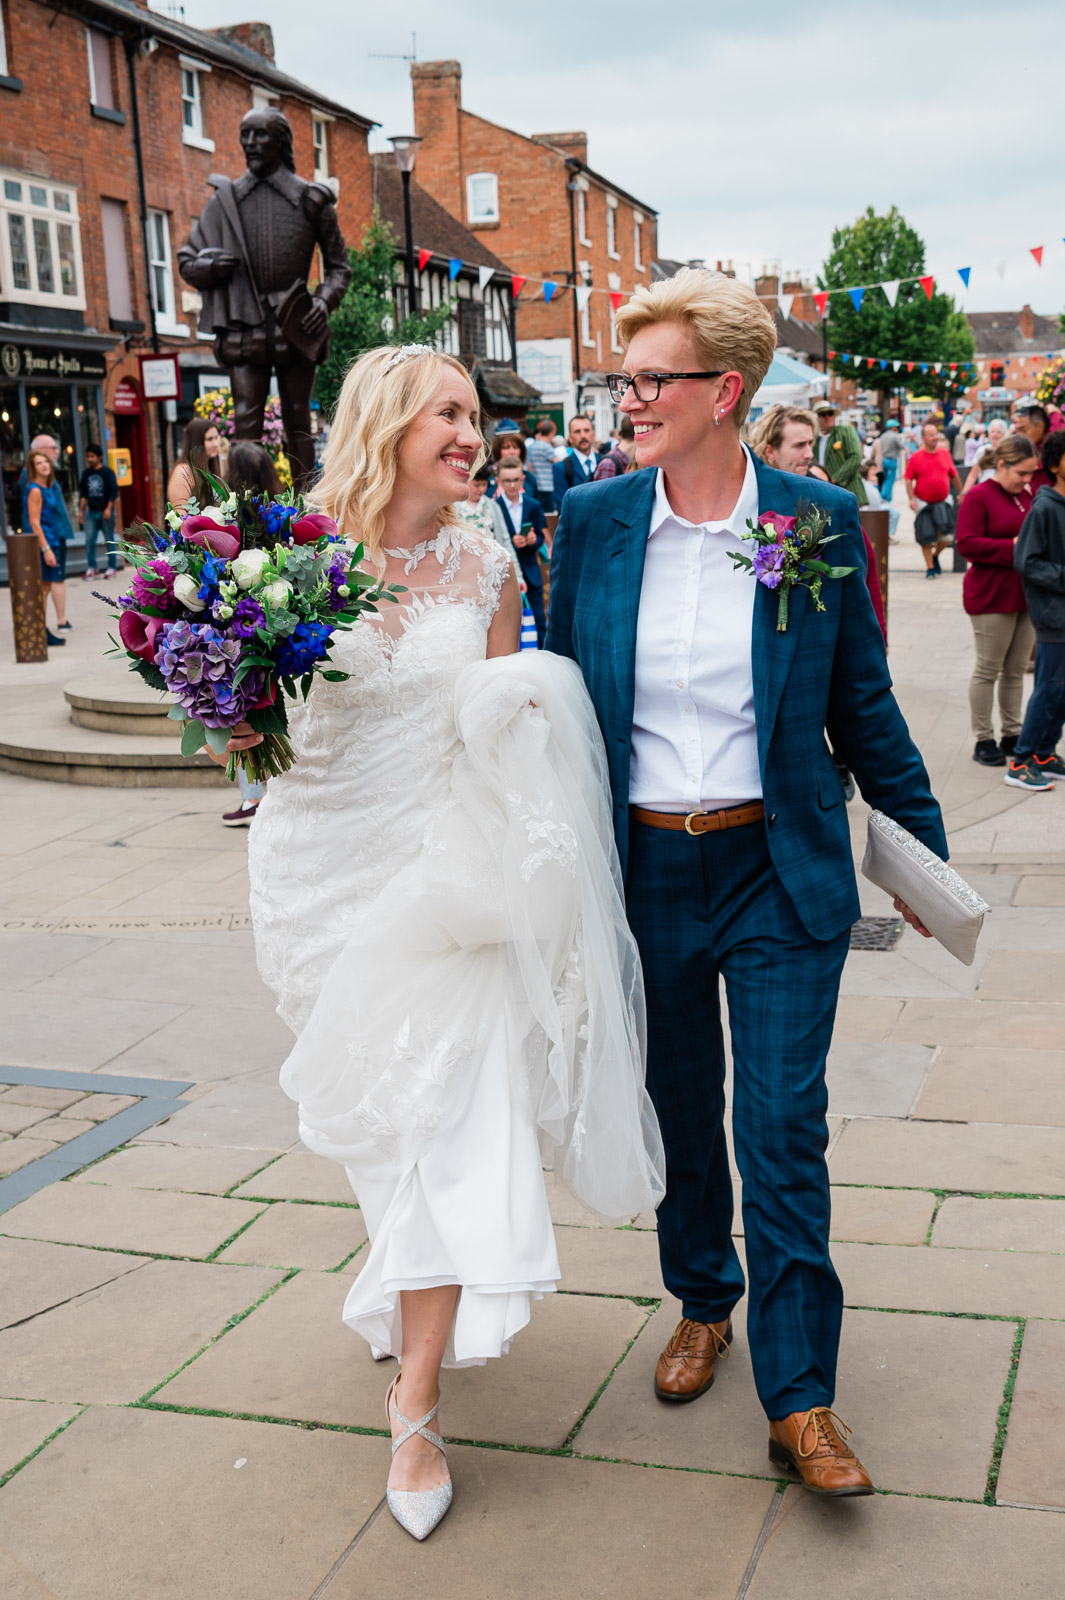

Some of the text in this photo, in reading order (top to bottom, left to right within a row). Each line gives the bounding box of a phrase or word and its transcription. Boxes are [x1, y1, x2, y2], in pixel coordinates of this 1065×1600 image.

[3, 921, 26, 929] O
[31, 920, 98, 930] brave
[160, 918, 223, 927] world
